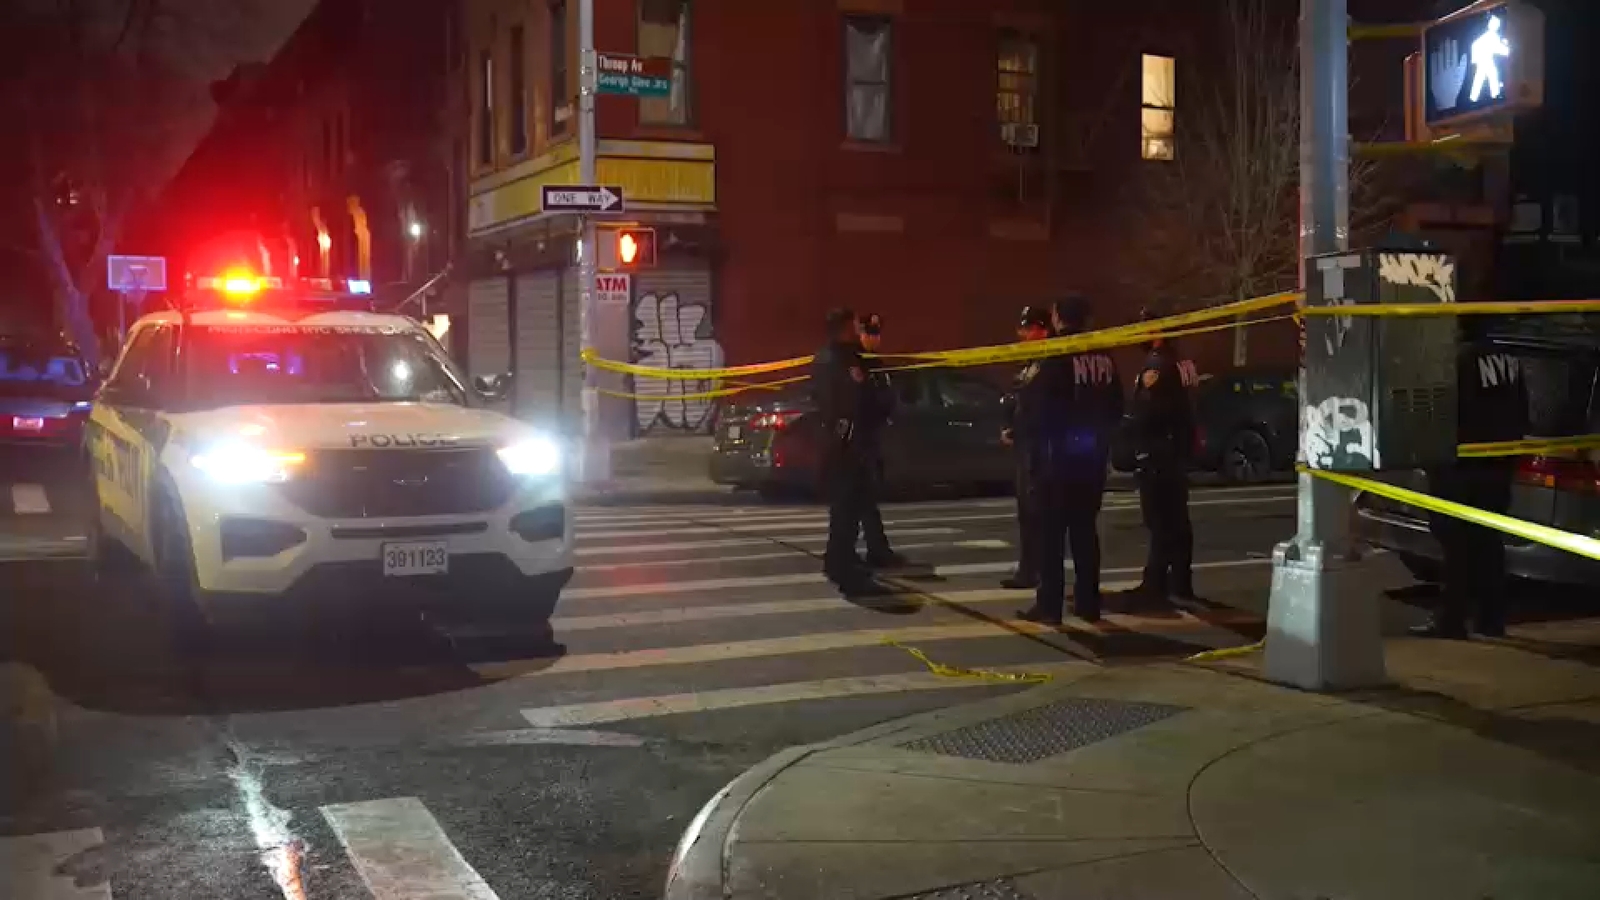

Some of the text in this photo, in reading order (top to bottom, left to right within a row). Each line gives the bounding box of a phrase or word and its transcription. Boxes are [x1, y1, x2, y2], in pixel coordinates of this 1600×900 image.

[553, 193, 612, 204] ONE WAY
[1073, 355, 1113, 384] NYPD
[349, 432, 458, 447] POLICE
[386, 548, 446, 568] 391123
